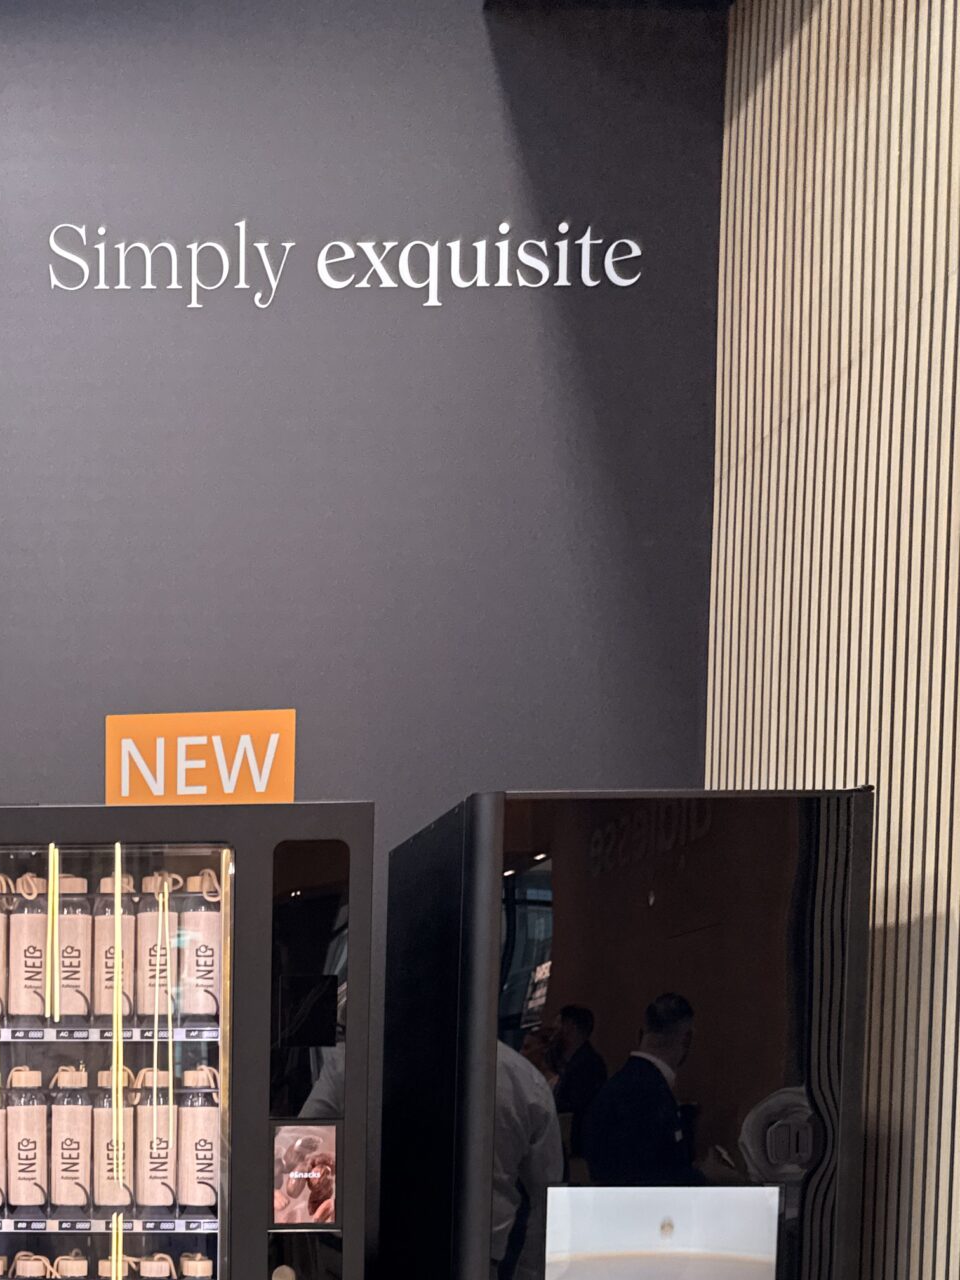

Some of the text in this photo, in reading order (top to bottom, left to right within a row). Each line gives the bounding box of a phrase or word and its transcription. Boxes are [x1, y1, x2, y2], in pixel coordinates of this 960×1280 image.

[49, 220, 641, 308] Simply exquisite
[121, 733, 280, 797] NEW
[289, 1170, 321, 1179] #Snacks
